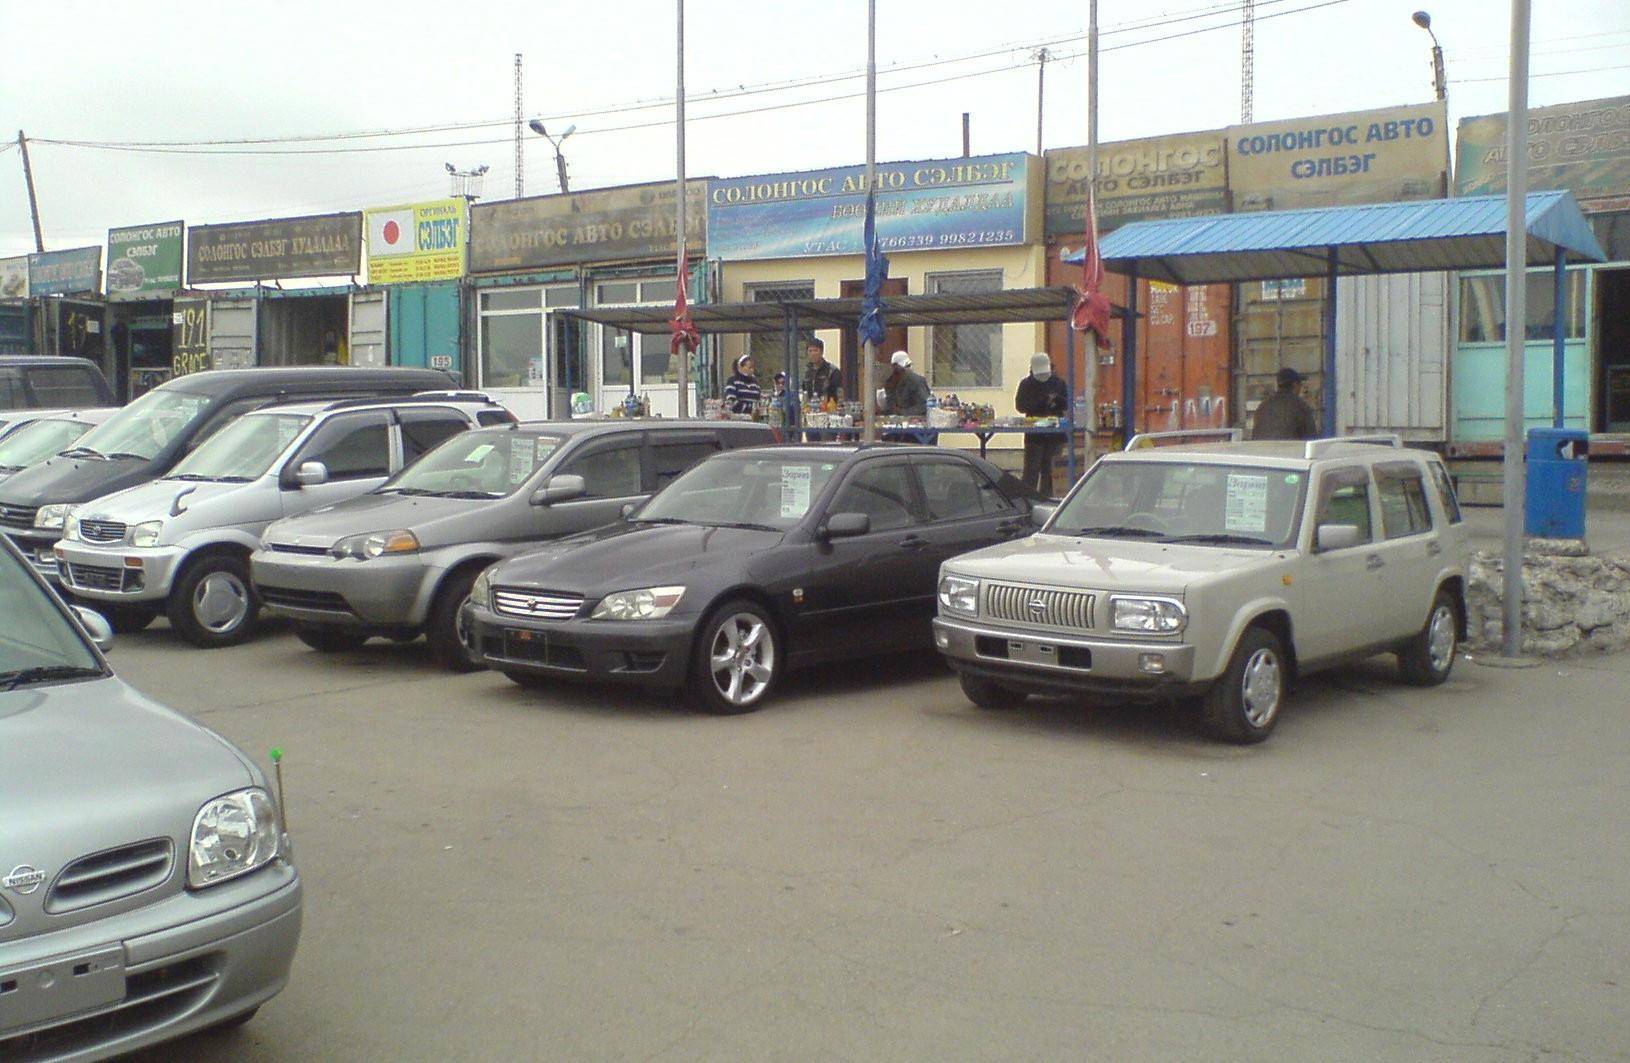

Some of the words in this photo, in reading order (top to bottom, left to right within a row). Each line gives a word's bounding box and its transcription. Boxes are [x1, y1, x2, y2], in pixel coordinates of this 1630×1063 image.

[1237, 125, 1358, 156] СОЛОНГОС
[1365, 117, 1434, 142] АВТО
[1291, 153, 1377, 179] СЭЛБЭГ
[712, 176, 833, 204] СОЛОНГОС
[913, 162, 1014, 187] СЭЛБЭГ
[1127, 170, 1205, 190] СЭЛБЭГ
[574, 222, 623, 244] АВТО
[939, 229, 1014, 245] 99821235
[177, 308, 206, 349] 191
